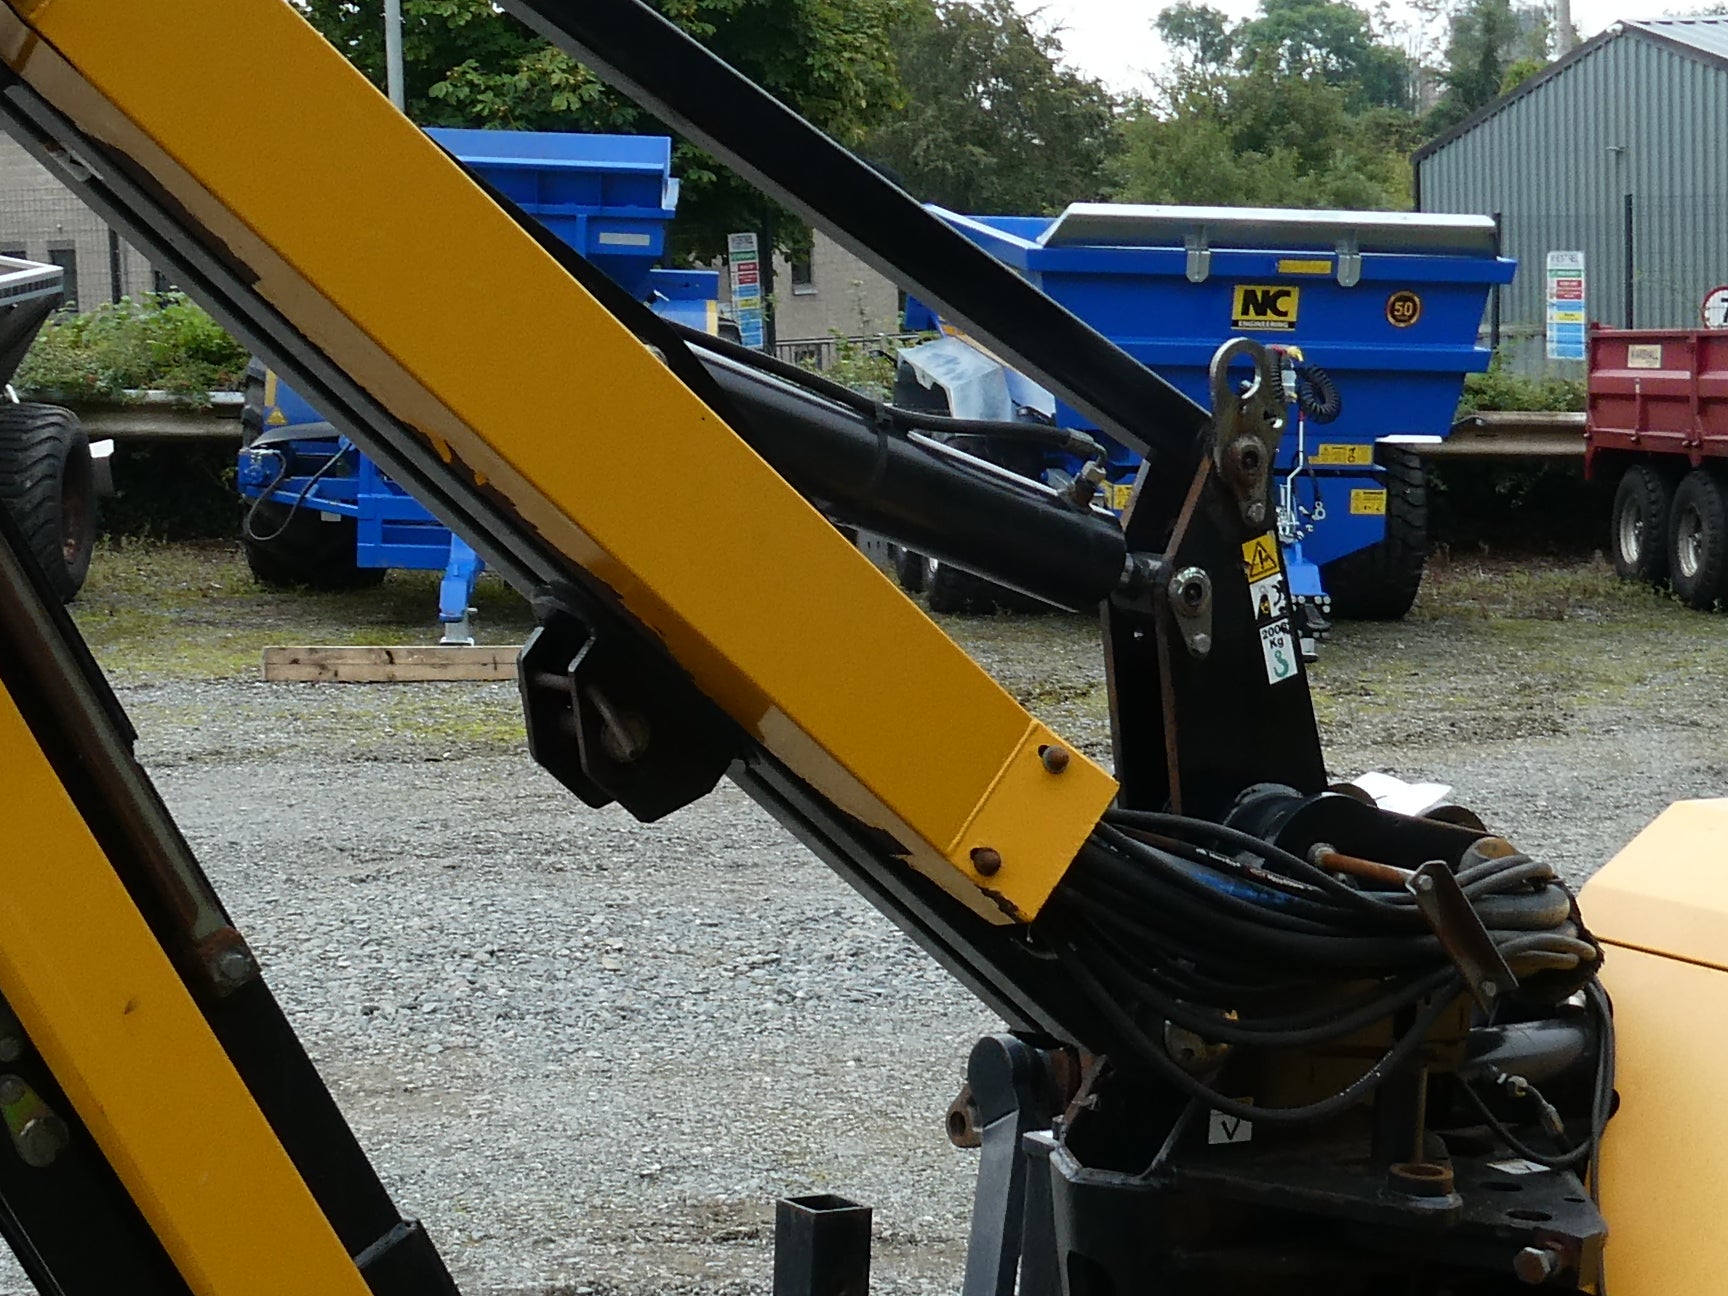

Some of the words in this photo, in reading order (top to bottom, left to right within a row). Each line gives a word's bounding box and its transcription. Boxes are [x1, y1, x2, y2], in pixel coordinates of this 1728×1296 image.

[1240, 289, 1292, 318] NC
[1394, 301, 1413, 316] 50
[1269, 637, 1285, 650] Kg
